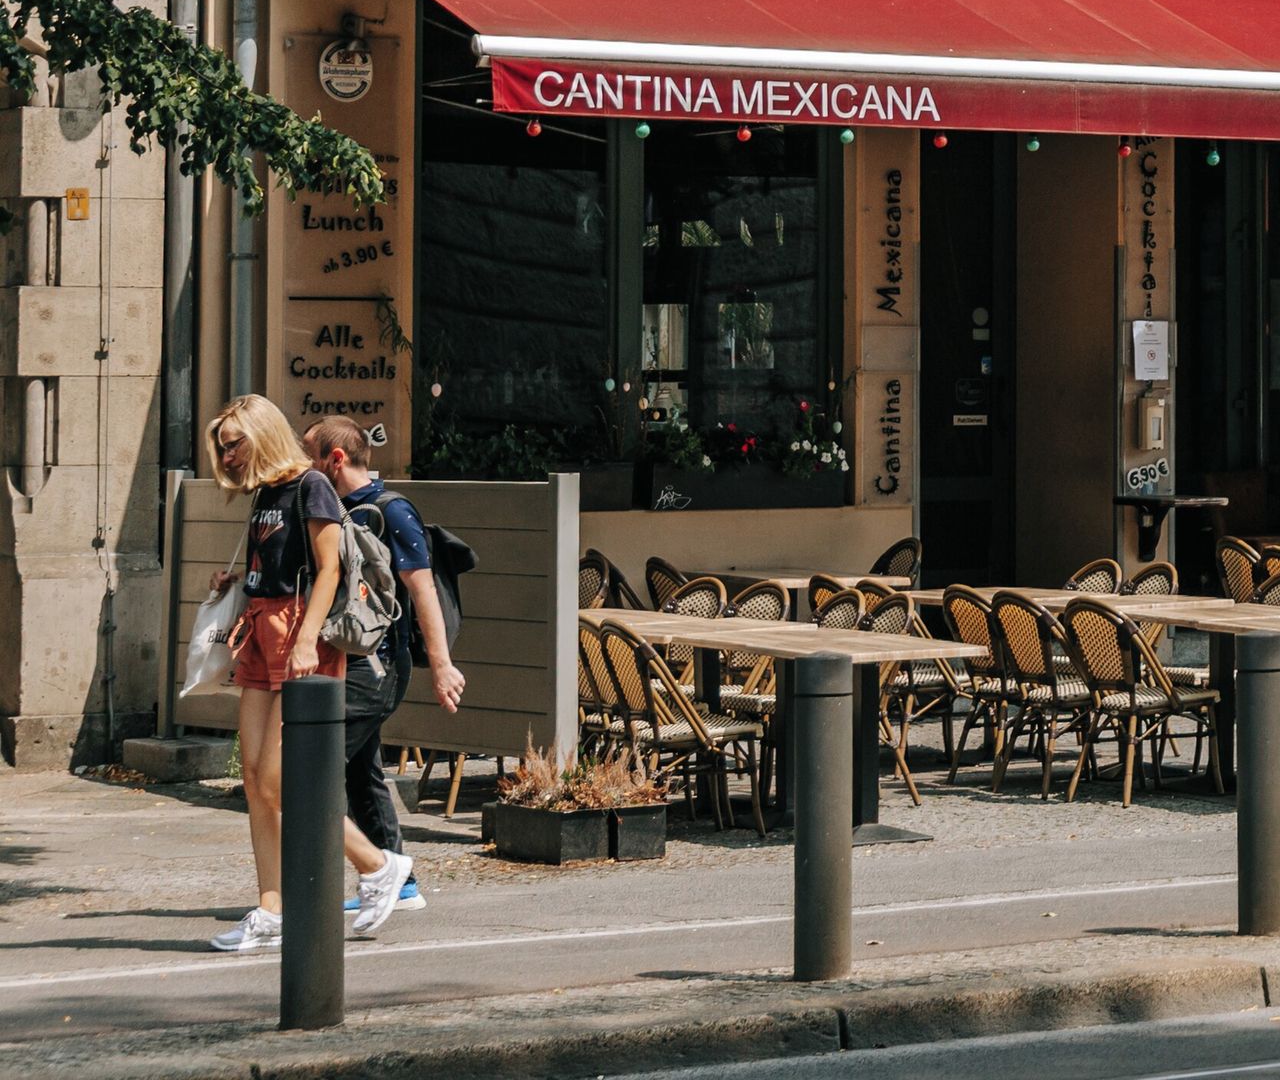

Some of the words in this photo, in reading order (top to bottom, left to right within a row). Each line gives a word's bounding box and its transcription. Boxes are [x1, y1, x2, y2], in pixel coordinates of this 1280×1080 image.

[534, 70, 722, 114] CANTINA
[732, 79, 941, 122] MEXICANA
[303, 204, 384, 232] Lunch
[876, 168, 903, 317] Mexicana
[322, 258, 340, 274] ab
[341, 244, 378, 268] 3.90
[382, 240, 394, 257] €
[314, 324, 364, 350] Alle
[289, 355, 396, 381] Cocktails
[301, 392, 385, 415] forever
[875, 379, 902, 497] Cantina
[1158, 461, 1168, 475] €
